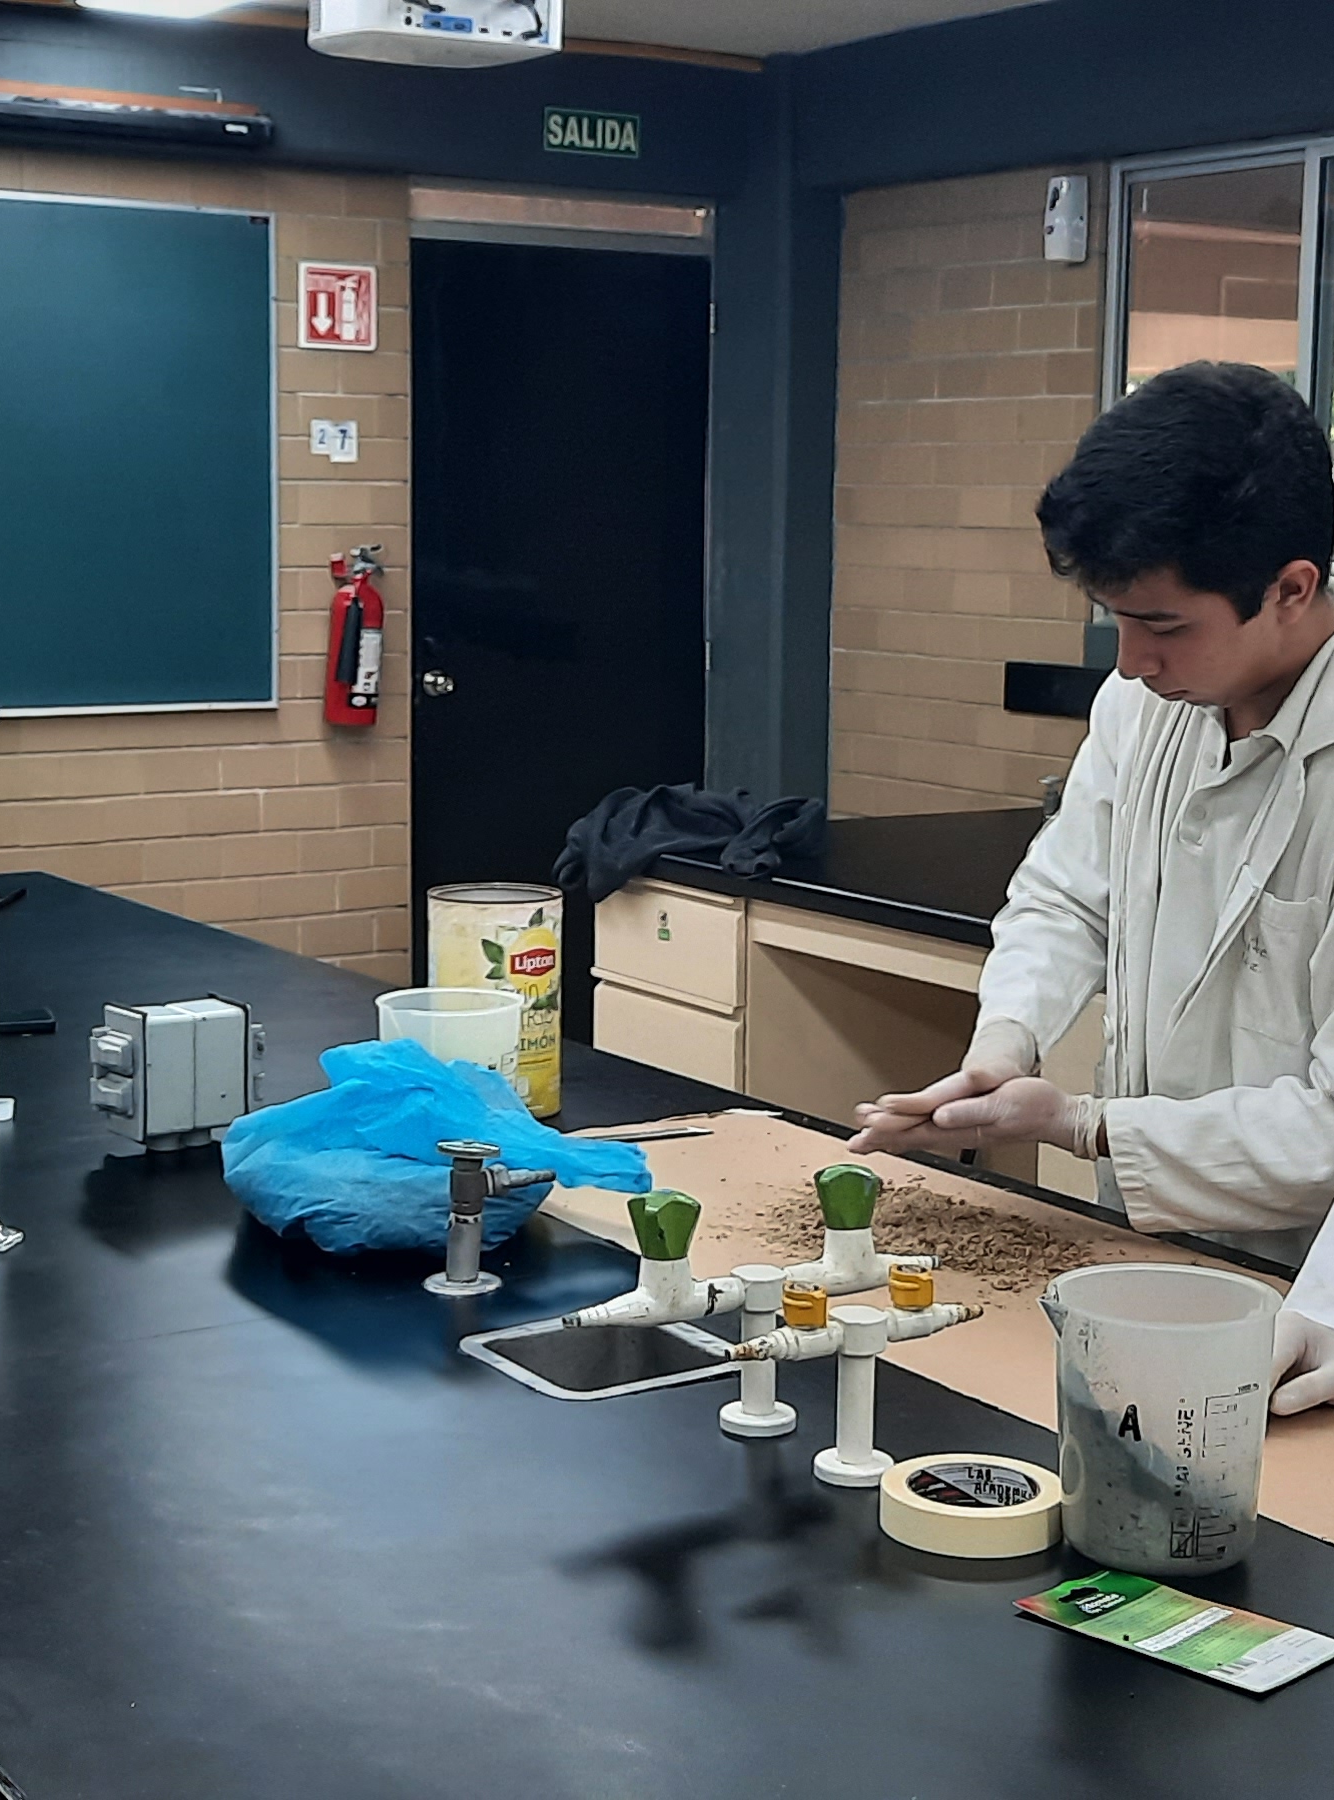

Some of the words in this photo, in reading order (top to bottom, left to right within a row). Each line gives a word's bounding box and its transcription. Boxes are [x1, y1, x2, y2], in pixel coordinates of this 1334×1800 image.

[548, 114, 636, 152] SALIDA
[515, 955, 555, 972] Lipton
[1119, 1404, 1142, 1441] A
